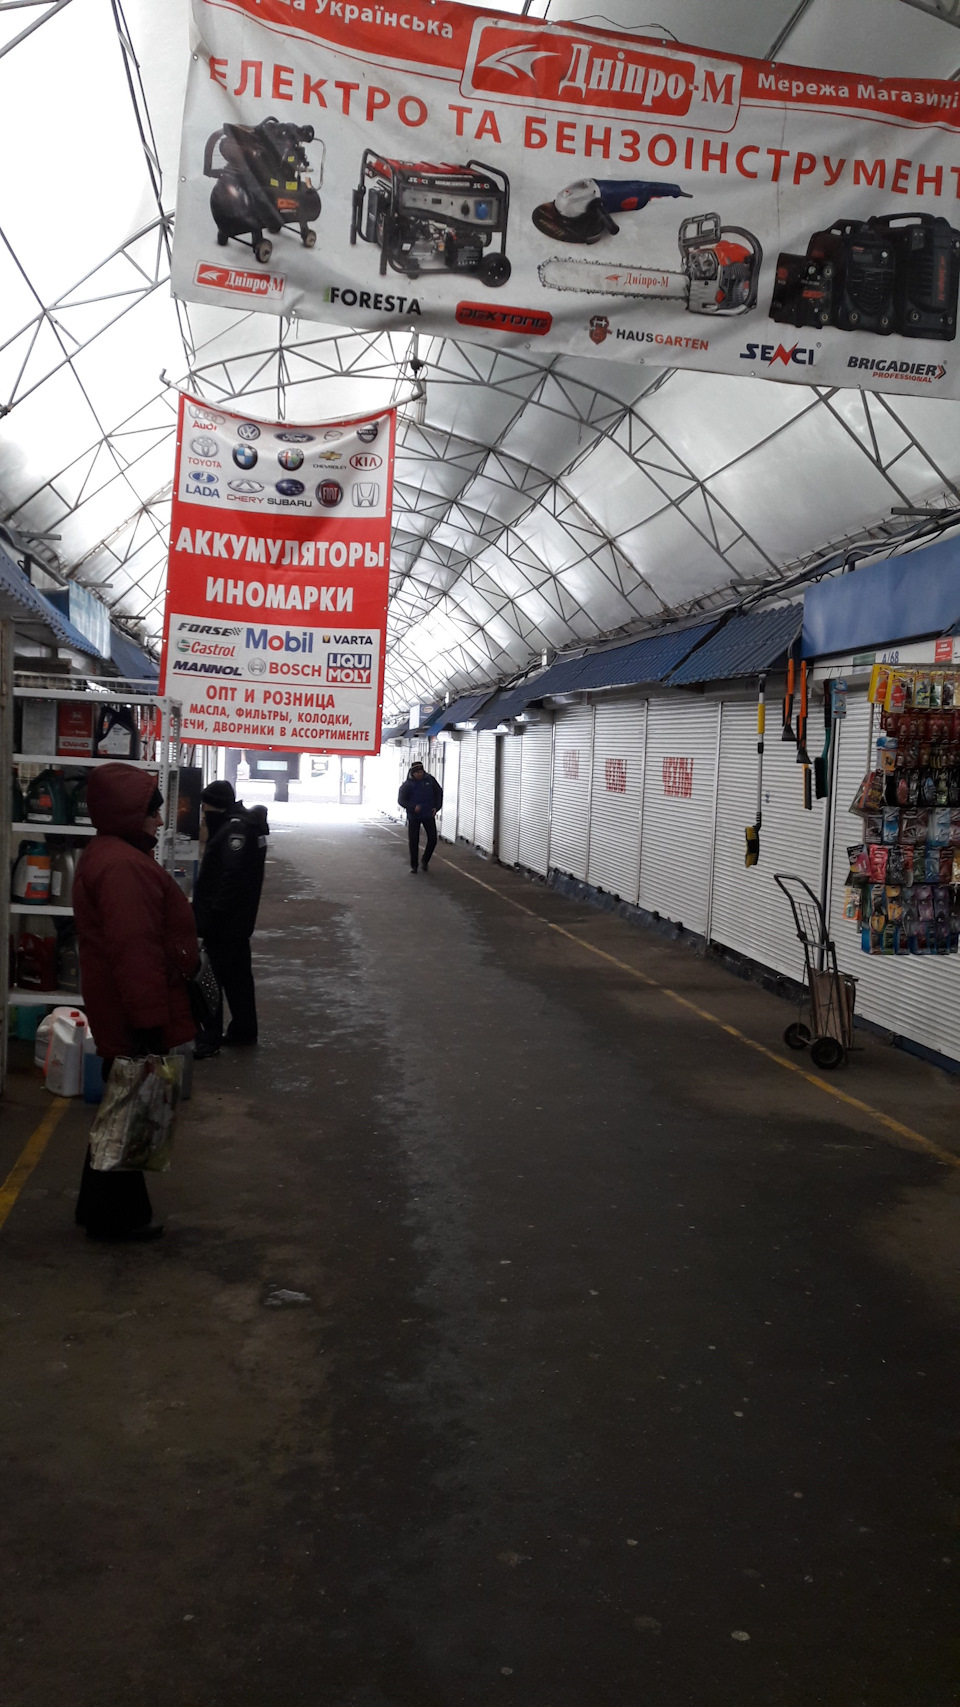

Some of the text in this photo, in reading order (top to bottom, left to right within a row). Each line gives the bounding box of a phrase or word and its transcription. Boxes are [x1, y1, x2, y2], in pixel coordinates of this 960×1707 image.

[559, 43, 735, 106] Дніпро-М
[757, 73, 849, 98] Мережа
[209, 55, 429, 128] ЕЛЕКТРО
[448, 104, 502, 144] ТА
[225, 270, 285, 293] Дніпро-М
[623, 272, 670, 289] Дніпро-М
[329, 286, 422, 316] FORESTA
[616, 327, 709, 351] HAUSGARTEN
[739, 341, 815, 367] SENCI
[847, 356, 939, 378] BRIGADIER
[872, 370, 933, 384] PROFESSIONAL
[188, 457, 222, 469] TOYOTA
[355, 456, 377, 467] KIA
[185, 483, 220, 498] LADA
[226, 493, 264, 504] CHERY
[322, 487, 339, 500] FIAT
[267, 497, 312, 508] SUBARU
[175, 526, 385, 568] АККУМУЛЯТОРЫ
[206, 576, 354, 612] ИНОМАРКИ
[177, 622, 233, 637] FORSE
[245, 627, 314, 653] Mobil
[333, 635, 373, 645] VARTA
[191, 641, 236, 657] Castrol
[172, 660, 243, 677] MANNOL
[328, 653, 371, 668] LIQUI
[269, 662, 322, 677] BOSCH
[327, 669, 371, 683] MOLY
[206, 684, 336, 711] ОПТ И РОЗНИЦА
[189, 703, 353, 727] МАСЛА, ФИЛЬТРЫ, КОЛОДКИ,
[170, 717, 370, 742] СЕЧИ, ДВОРНИКИ В АССОРТИМЕНТЕ
